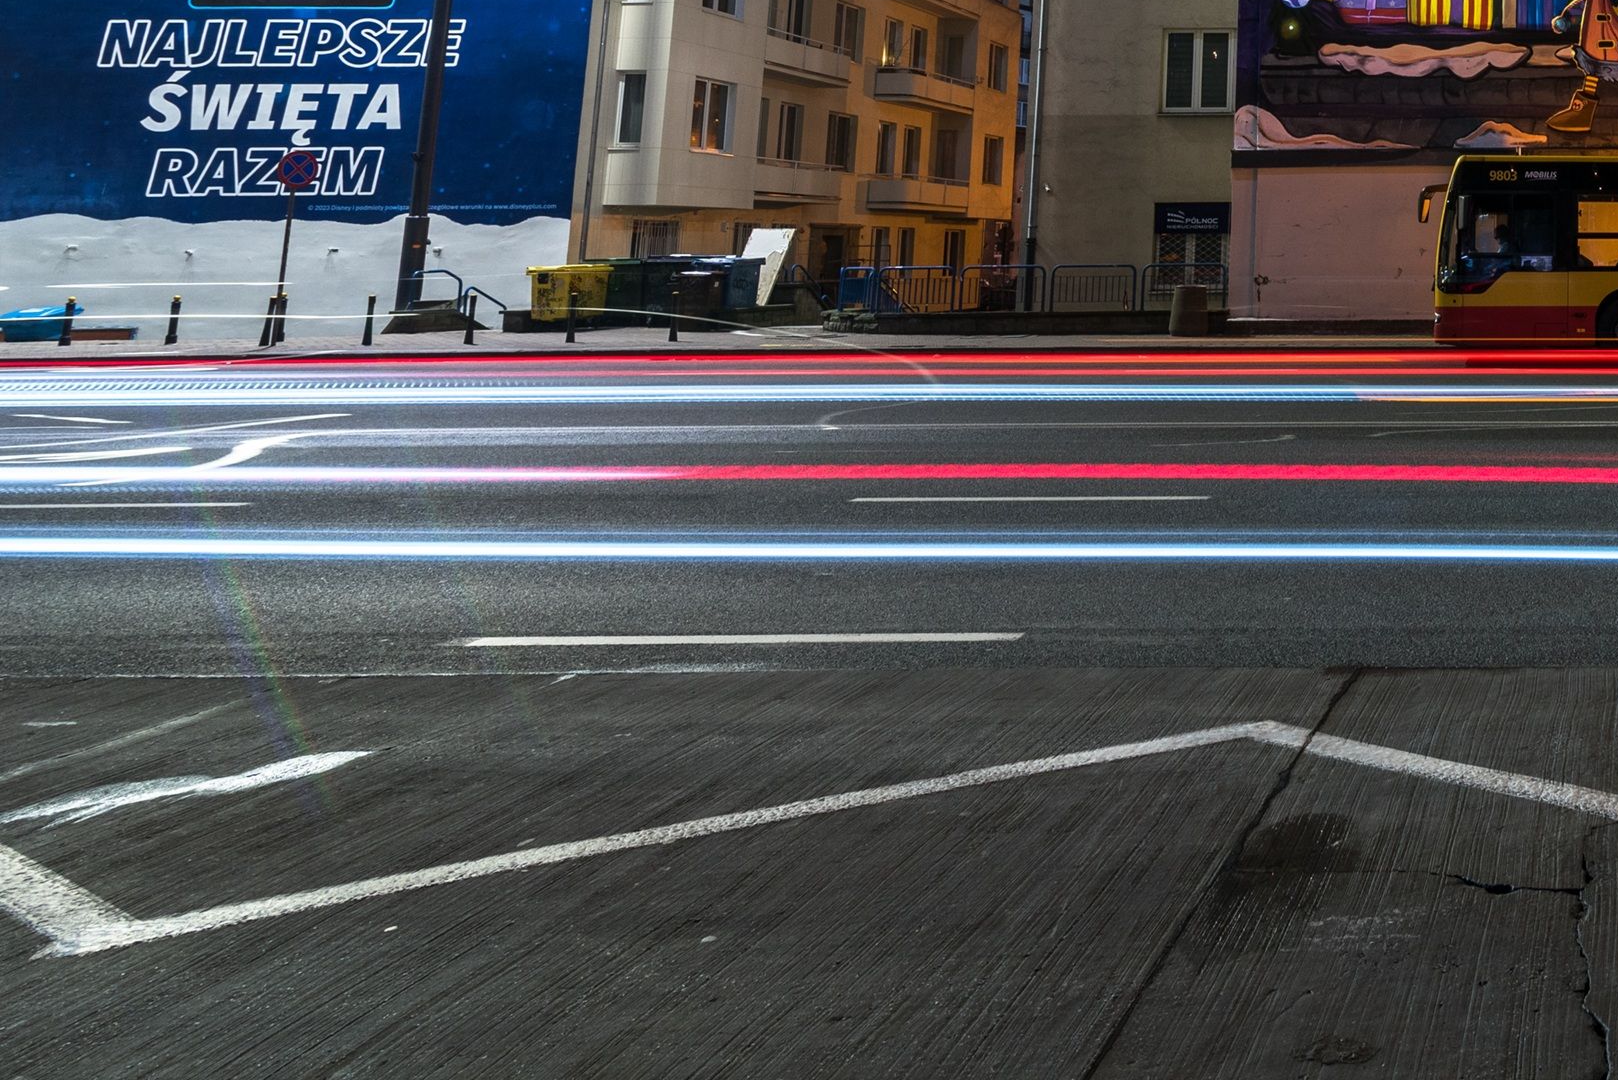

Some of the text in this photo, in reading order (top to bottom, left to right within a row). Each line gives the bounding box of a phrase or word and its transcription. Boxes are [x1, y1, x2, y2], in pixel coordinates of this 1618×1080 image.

[97, 18, 467, 68] NAJLEPSZE
[140, 70, 402, 147] ŚWIĘTA
[1489, 170, 1518, 181] 9803
[1524, 170, 1558, 179] MOBILIS
